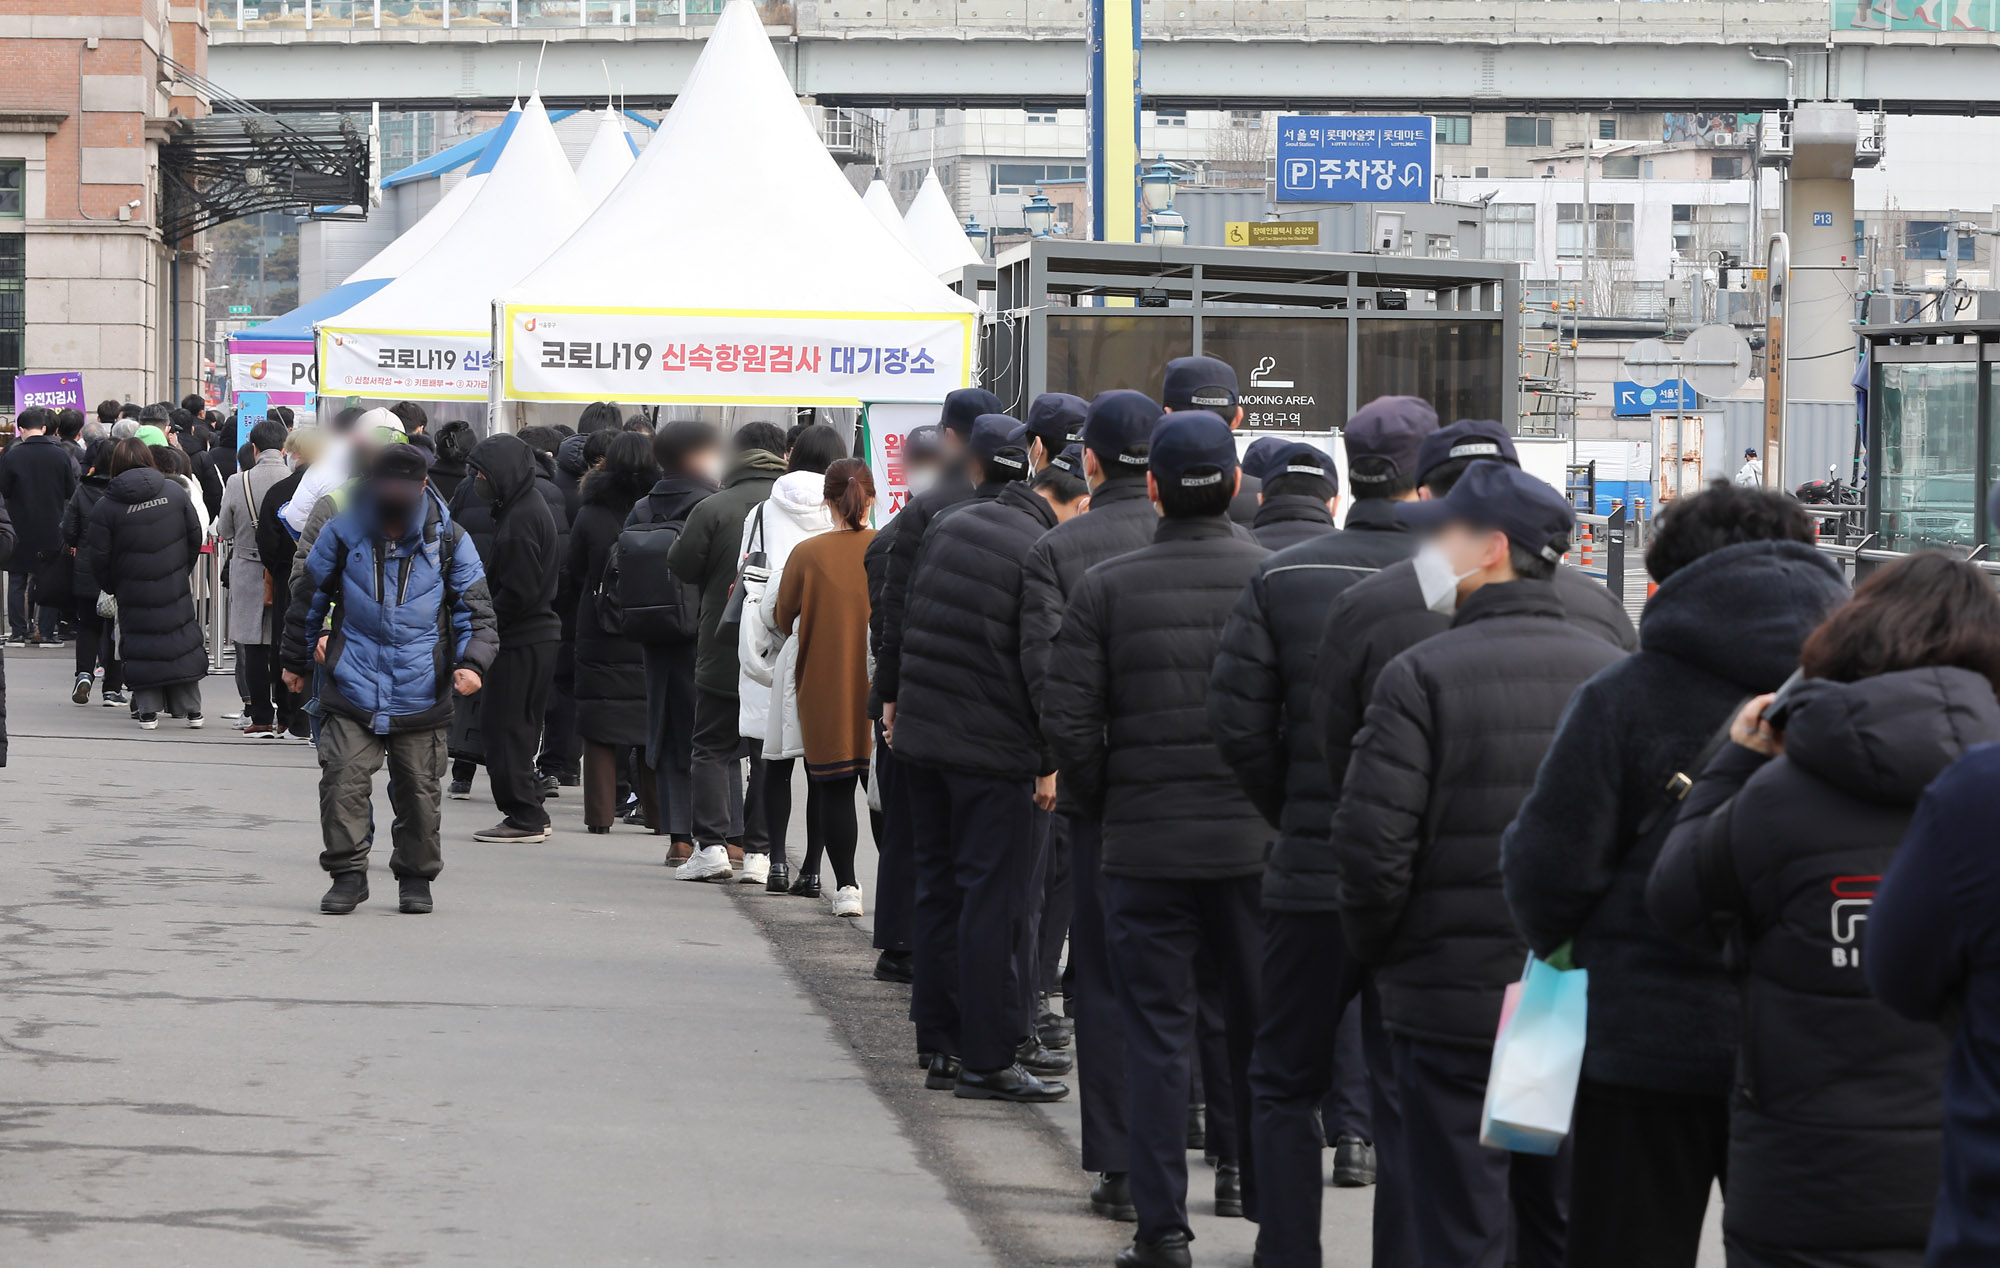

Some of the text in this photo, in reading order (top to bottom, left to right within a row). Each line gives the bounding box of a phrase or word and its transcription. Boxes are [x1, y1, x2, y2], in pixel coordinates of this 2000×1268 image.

[1327, 129, 1376, 142] 롯데아울렛
[1383, 129, 1428, 142] 롯데마트
[1292, 162, 1308, 185] P
[1319, 158, 1397, 191] 주차장
[1814, 214, 1832, 224] P13
[1294, 226, 1314, 235] 승강장
[378, 348, 457, 370] 코로나19
[541, 341, 936, 374] 코로나19 신속항원검사 대기장소
[355, 377, 393, 386] 신청서작성
[414, 378, 444, 388] 키트배부
[24, 390, 77, 407] 유전자검사
[1284, 395, 1316, 406] AREA
[1248, 412, 1301, 427] 흡연구역
